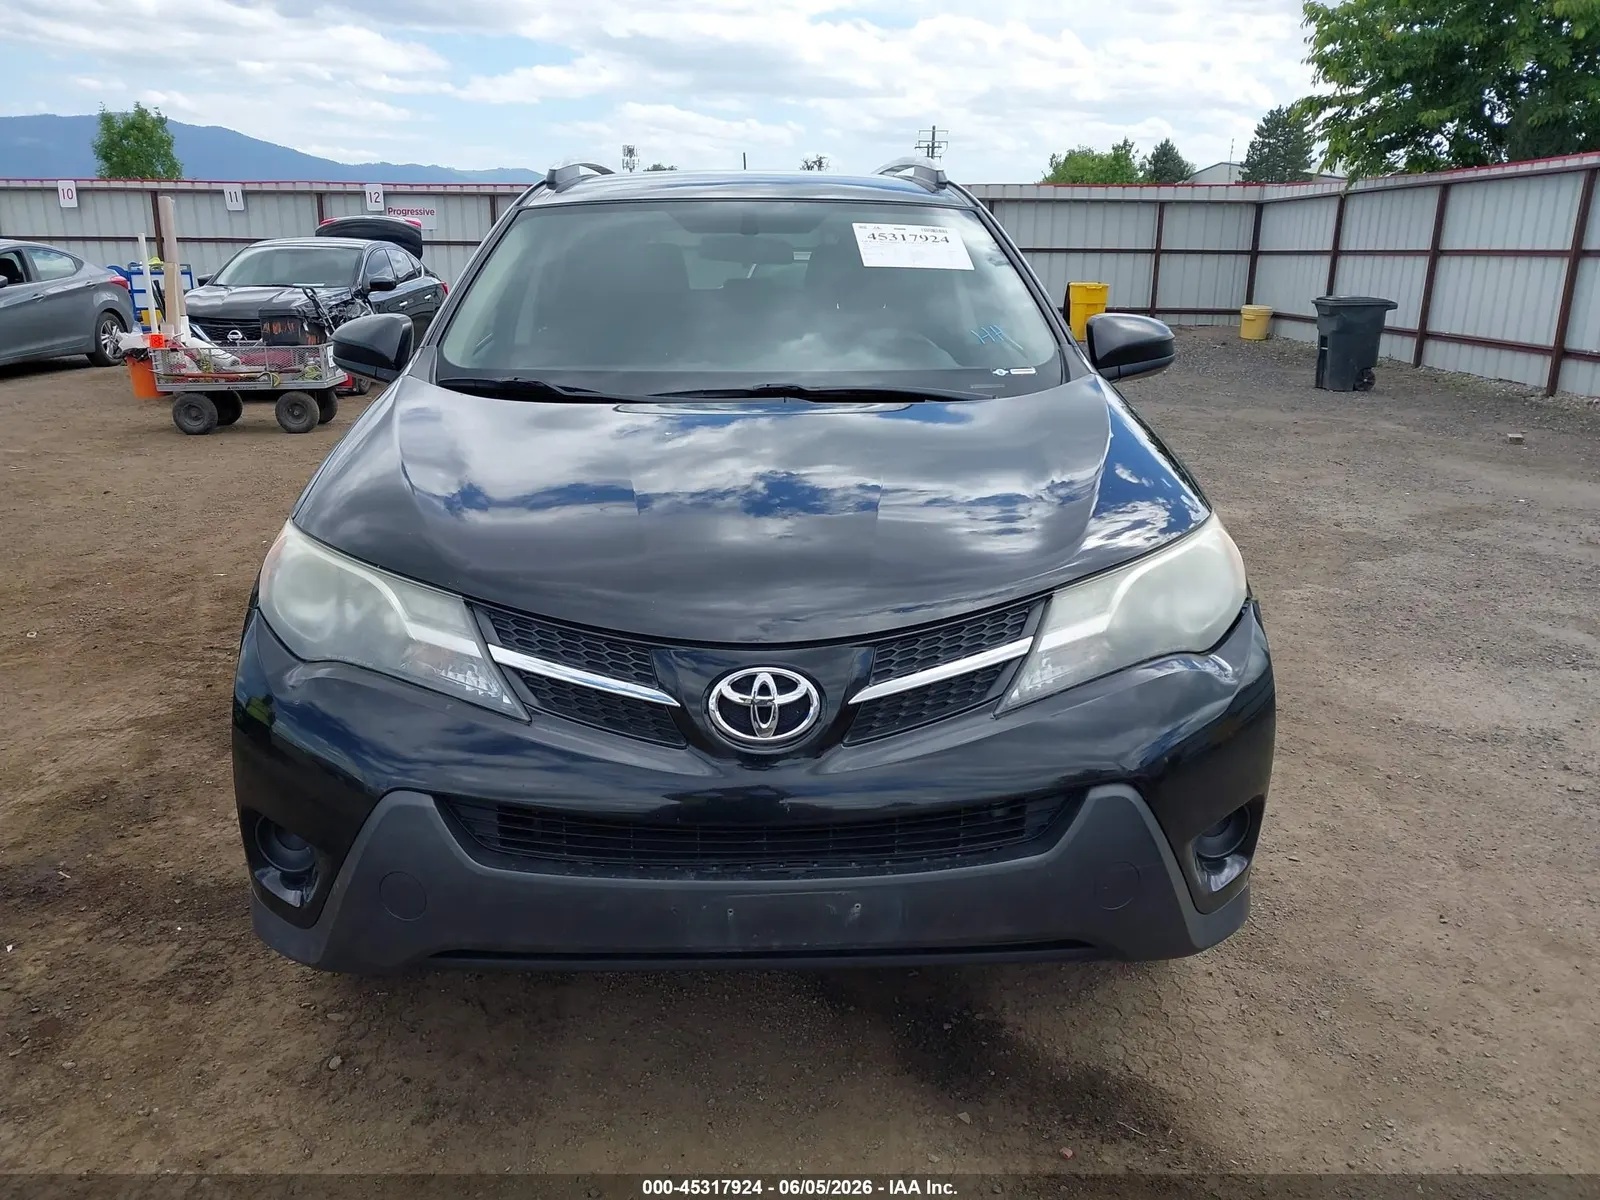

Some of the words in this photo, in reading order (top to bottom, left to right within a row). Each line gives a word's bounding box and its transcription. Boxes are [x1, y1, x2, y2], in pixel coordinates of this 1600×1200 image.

[60, 188, 74, 200] 10
[227, 191, 239, 203] 11
[369, 191, 381, 204] 12
[387, 207, 435, 217] Progressive
[867, 232, 950, 244] 45317924
